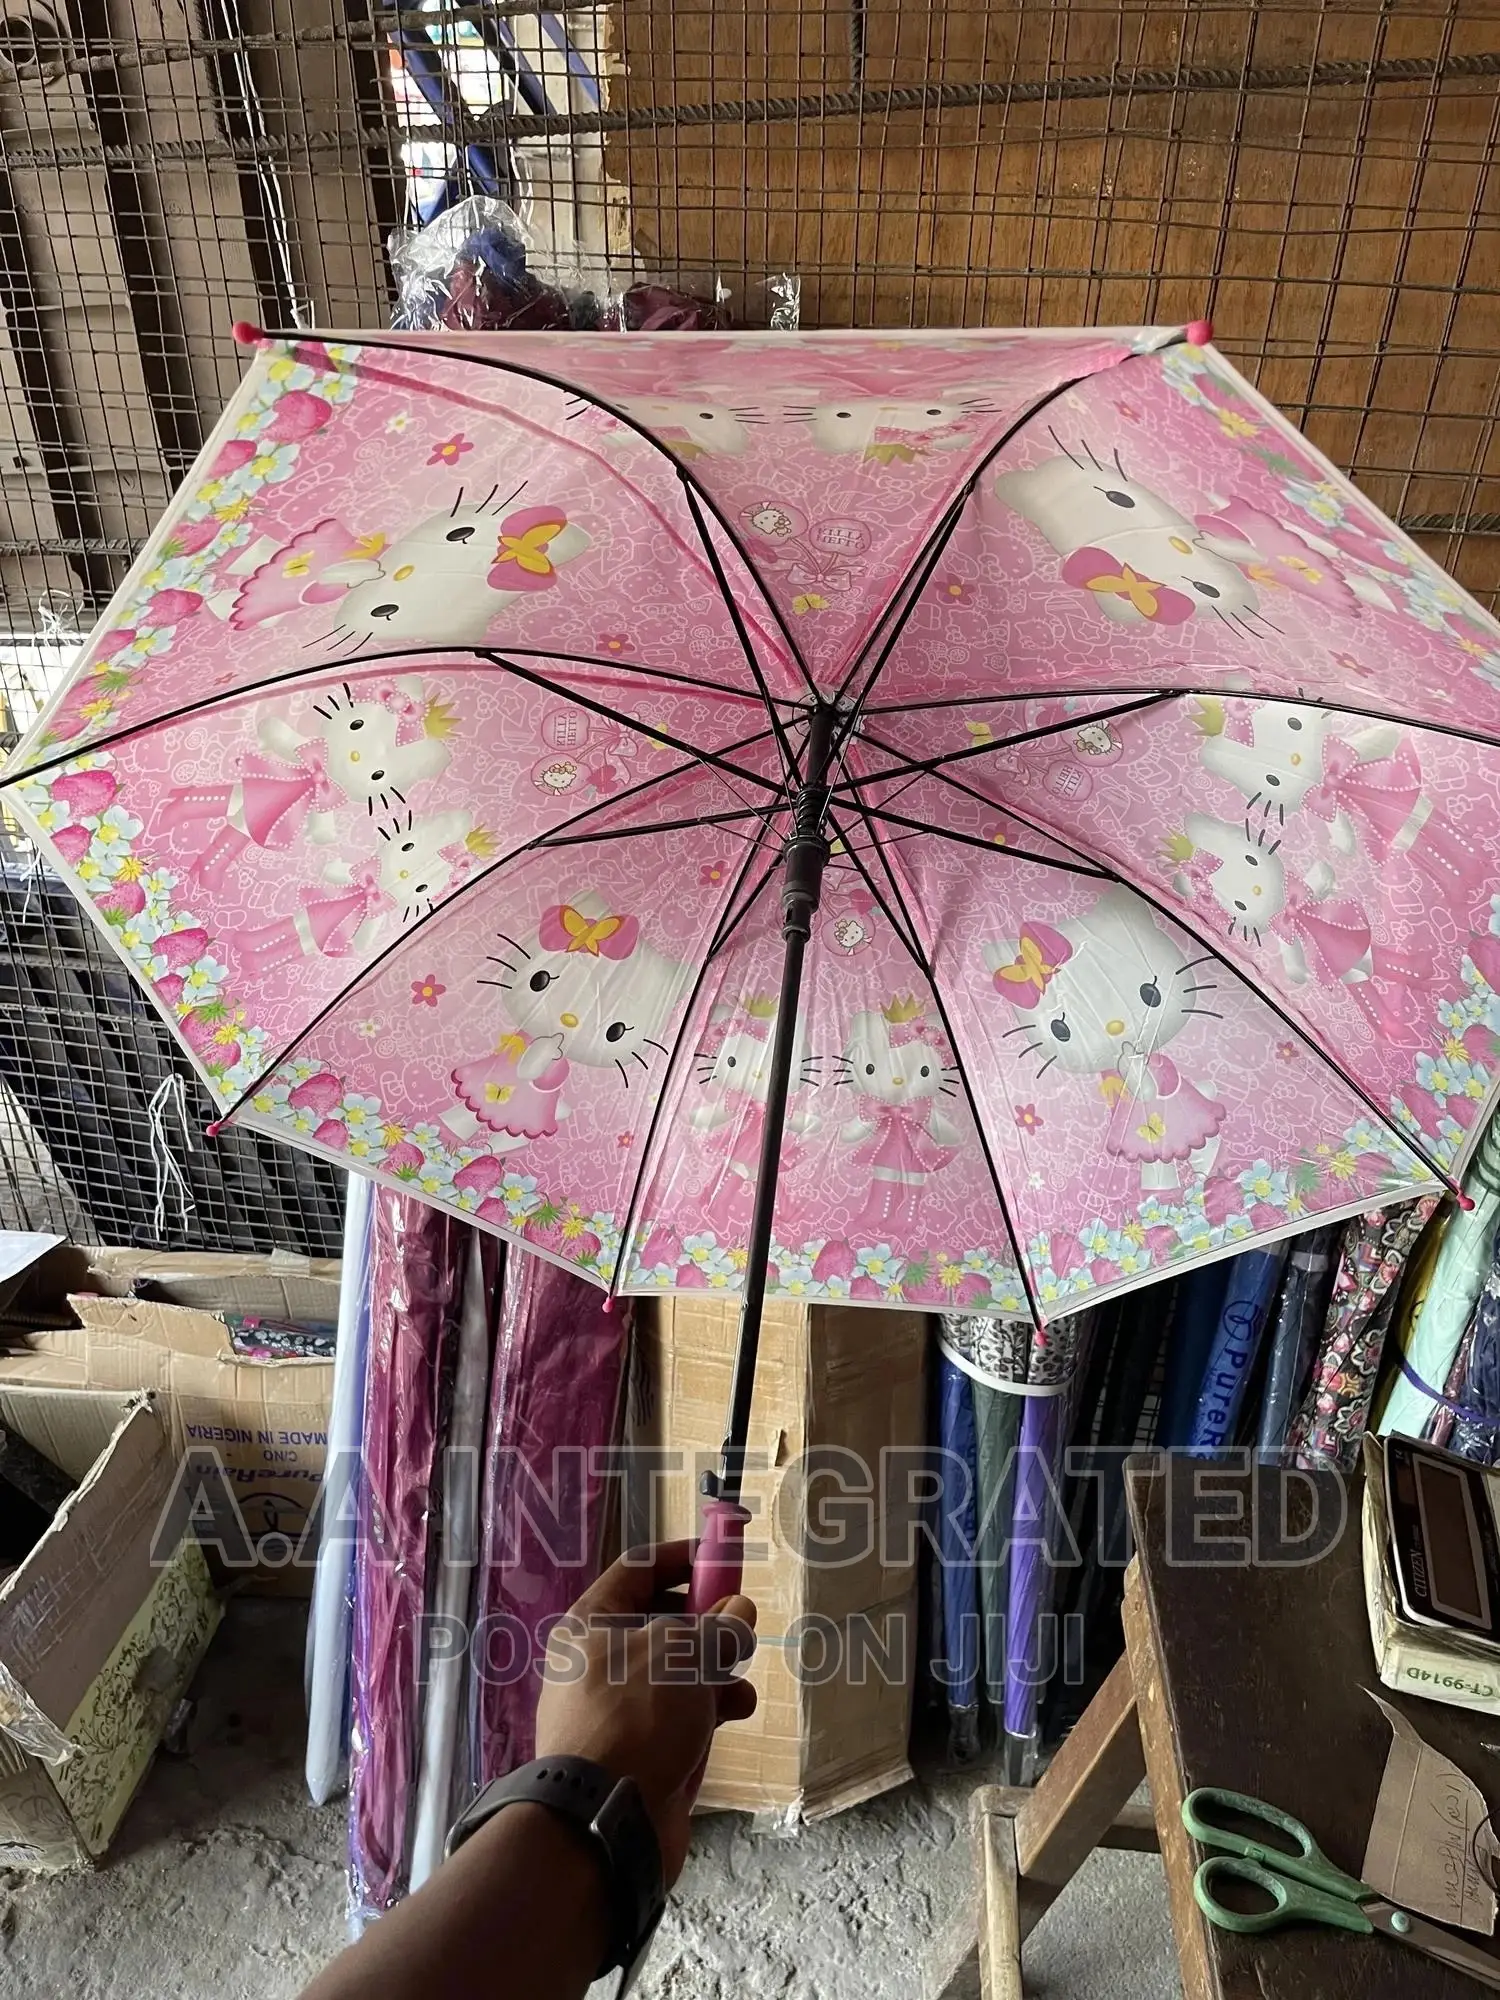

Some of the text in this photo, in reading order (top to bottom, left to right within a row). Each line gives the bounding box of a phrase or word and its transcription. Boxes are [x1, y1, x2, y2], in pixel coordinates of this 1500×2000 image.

[186, 1423, 328, 1446] MADE IN NIGERIA
[195, 1464, 325, 1484] PureRain
[1410, 1548, 1427, 1597] CITIZEN
[1406, 1667, 1494, 1697] CT-9914D
